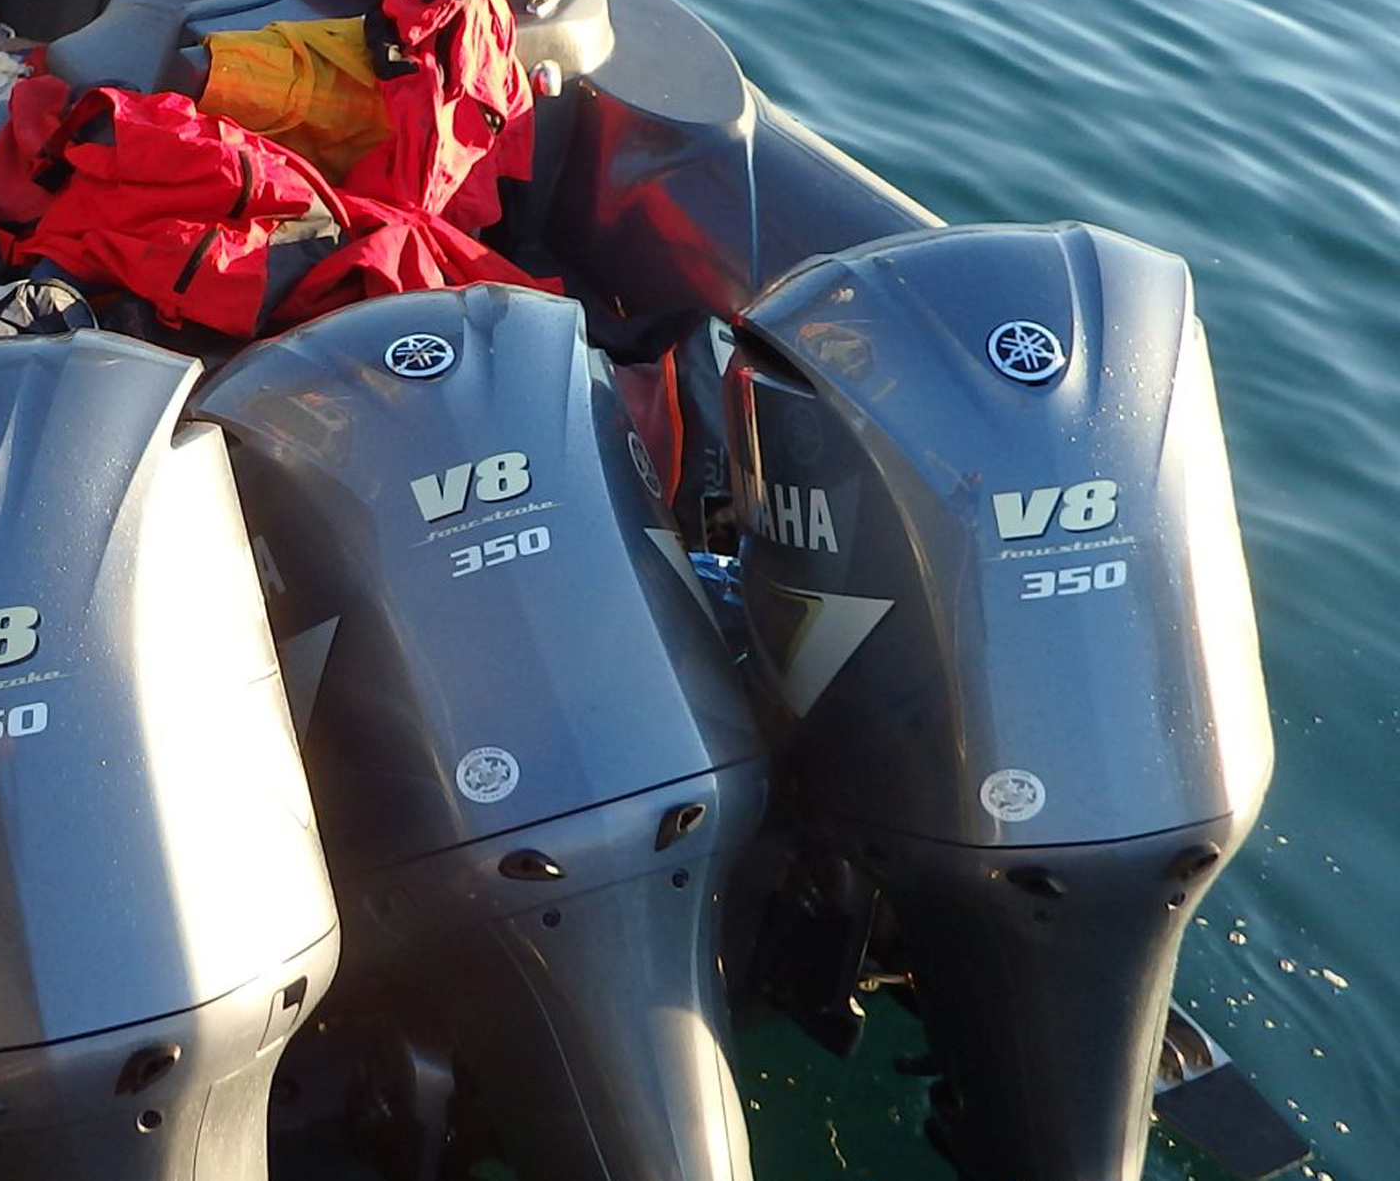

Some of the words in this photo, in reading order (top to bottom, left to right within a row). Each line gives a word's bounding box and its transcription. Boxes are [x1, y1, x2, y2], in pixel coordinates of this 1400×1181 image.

[410, 451, 532, 524] V8
[992, 479, 1119, 542] V8
[450, 526, 551, 578] 350
[1020, 560, 1127, 601] 350
